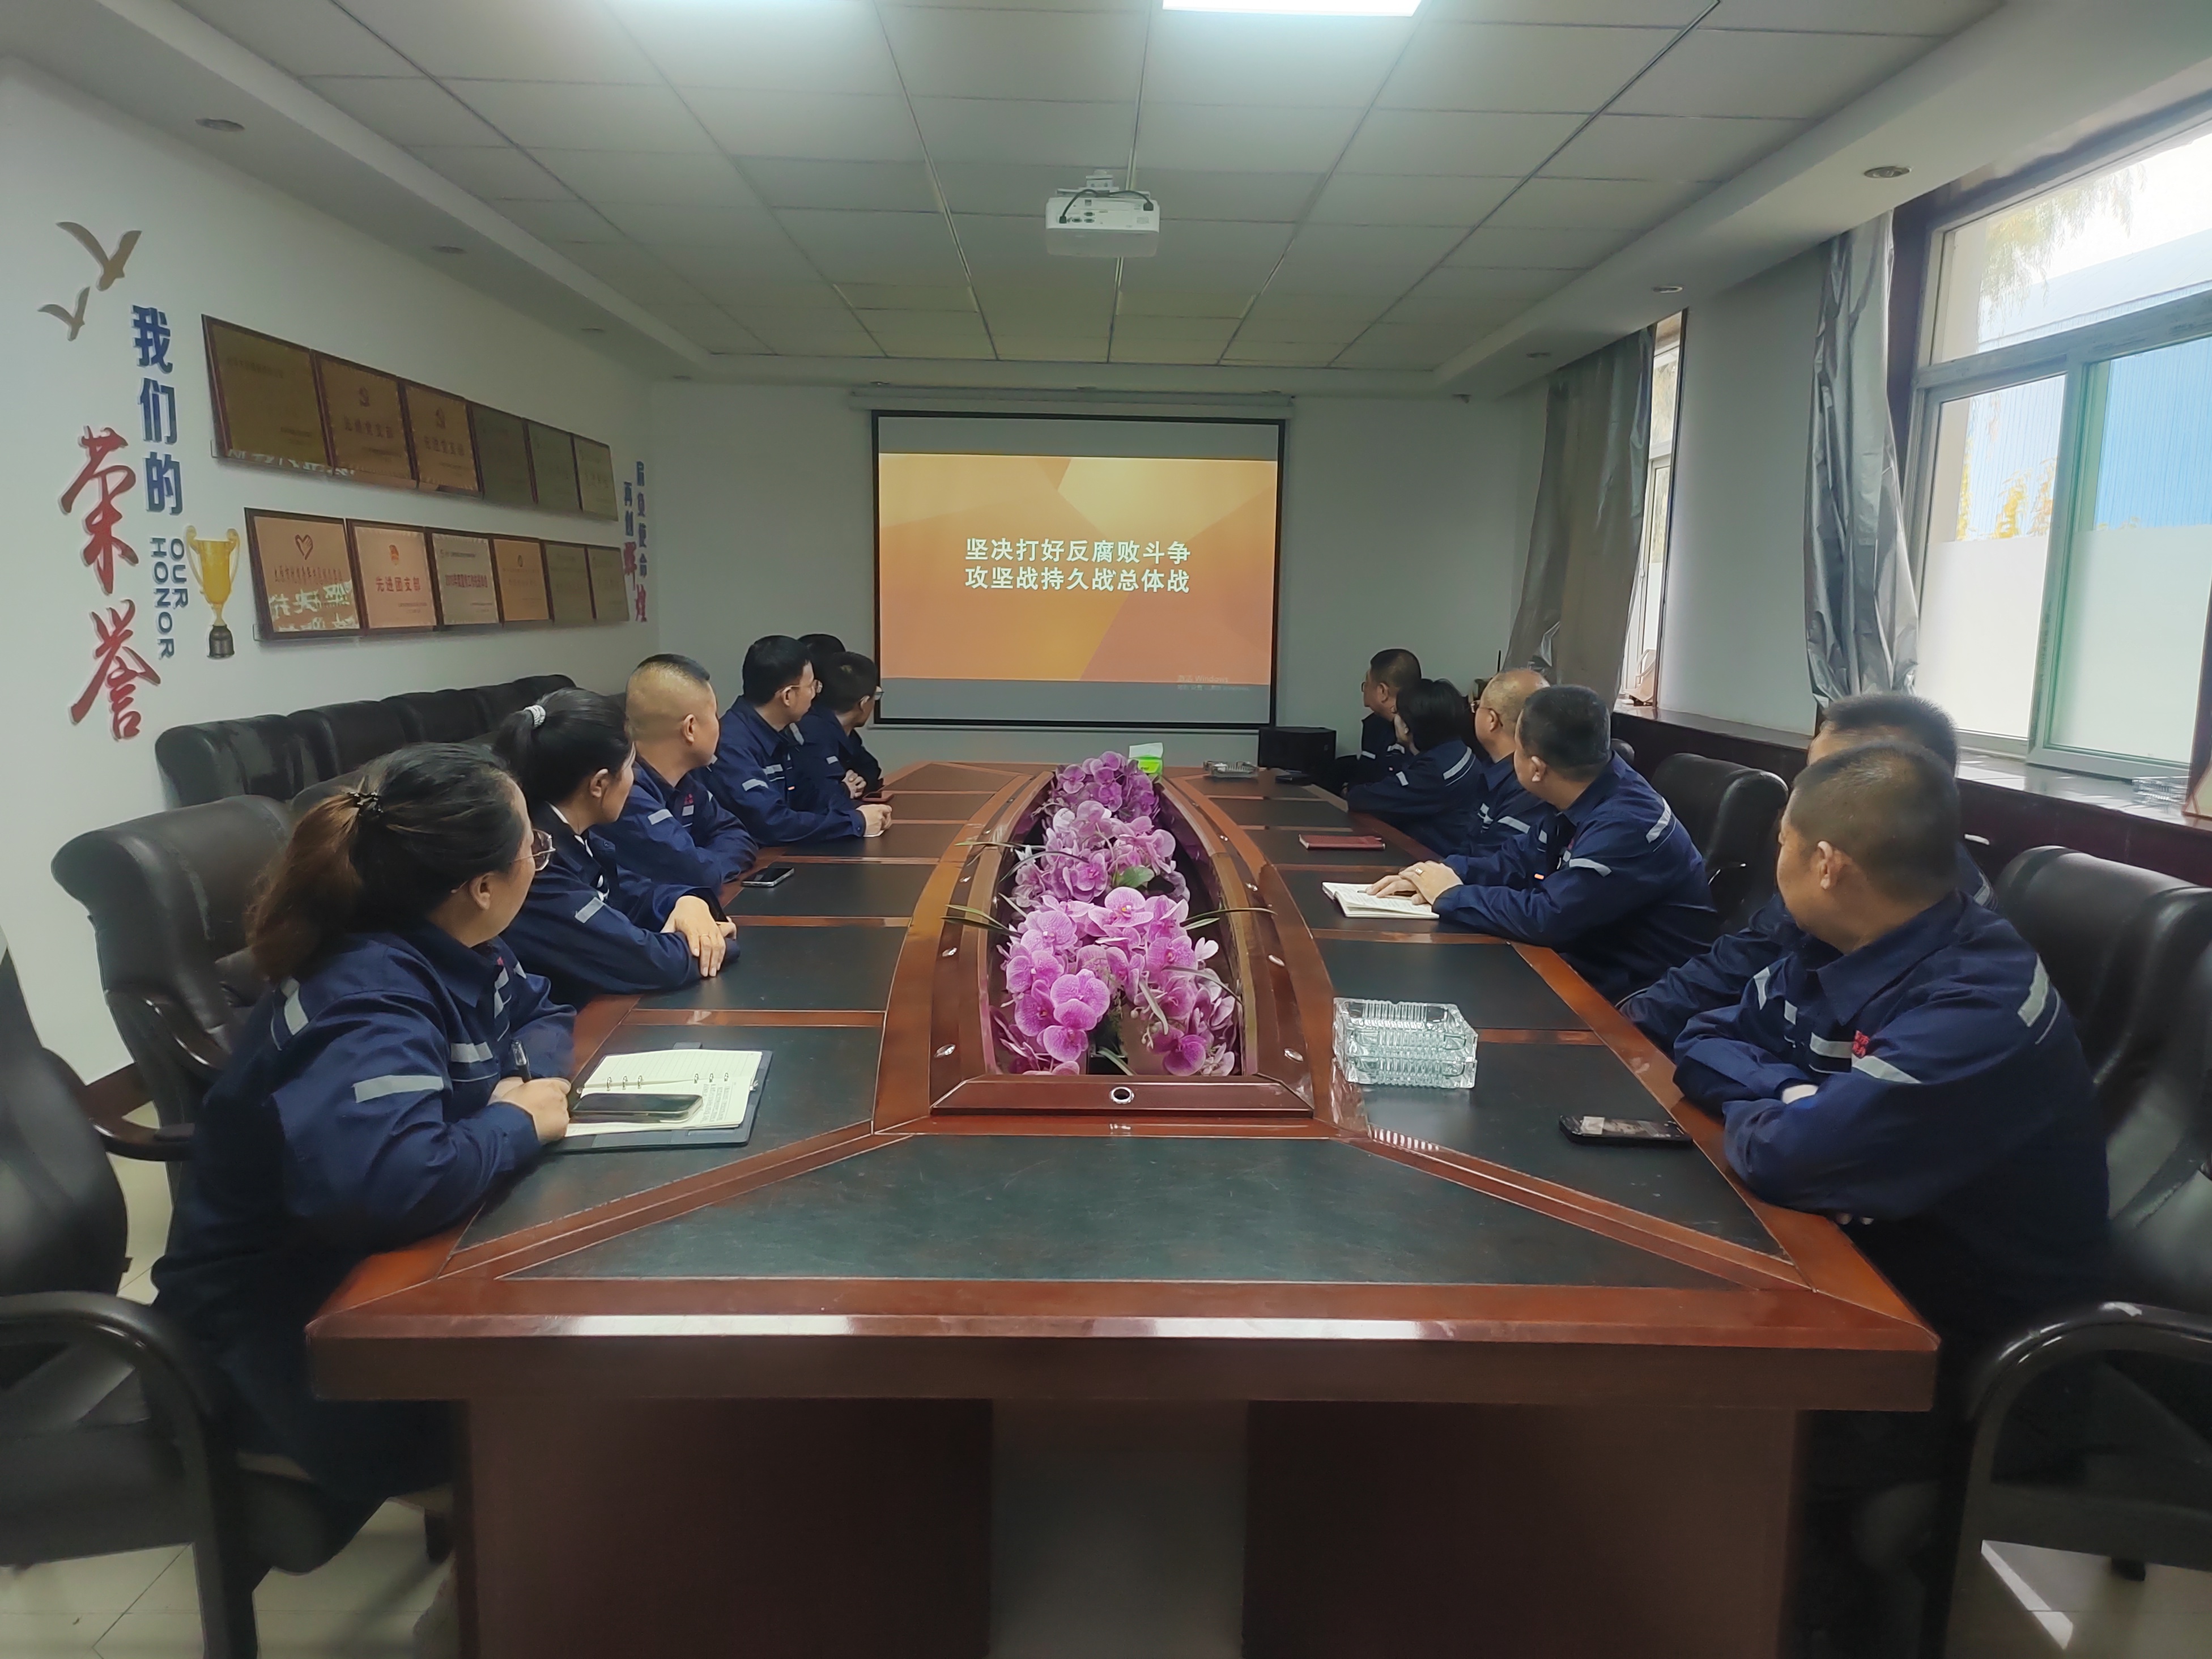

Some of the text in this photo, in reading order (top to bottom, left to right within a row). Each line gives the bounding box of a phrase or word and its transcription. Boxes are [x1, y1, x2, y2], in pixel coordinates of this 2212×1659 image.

[132, 305, 183, 515] 我们的
[58, 425, 161, 741] 荣誉
[171, 538, 189, 610] OUR
[376, 576, 421, 593] 先进团支部
[965, 537, 1191, 565] 坚决打好反腐败斗争
[965, 565, 1191, 593] 攻坚战持久战总体战
[150, 537, 175, 661] HONOR
